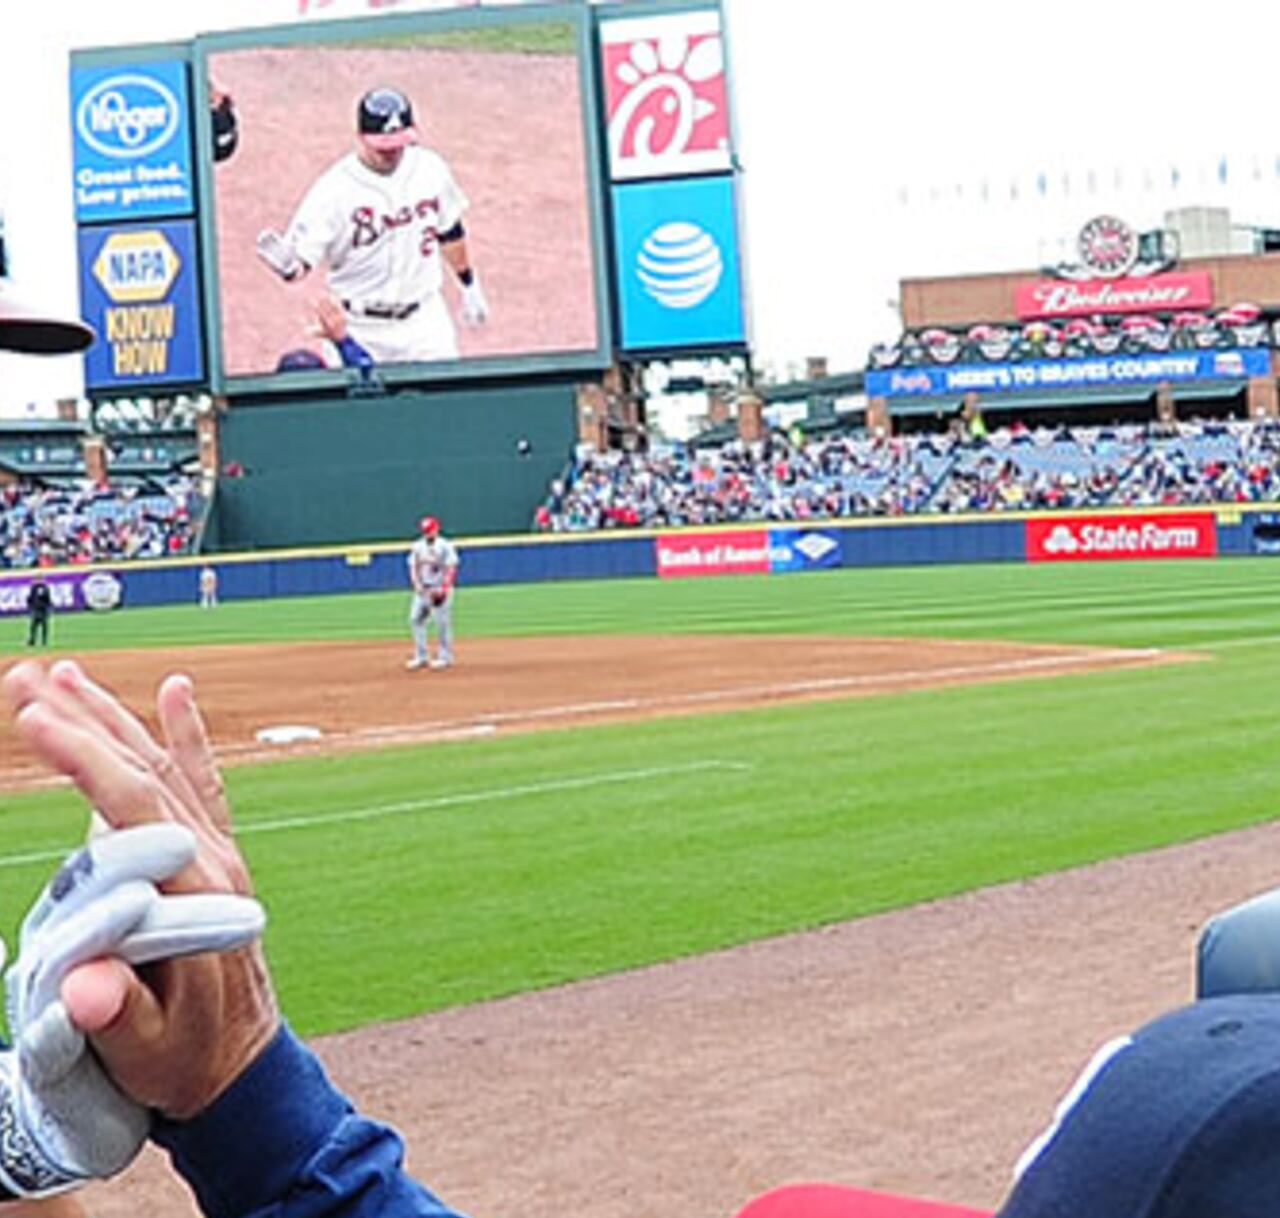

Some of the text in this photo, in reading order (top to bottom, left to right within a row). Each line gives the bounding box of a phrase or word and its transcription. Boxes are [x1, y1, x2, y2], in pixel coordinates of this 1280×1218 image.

[91, 91, 167, 146] Kroger
[77, 187, 117, 205] Low
[109, 251, 168, 283] NAPA
[1033, 282, 1192, 314] Budweiser
[105, 303, 175, 342] KNOW
[114, 339, 168, 375] HOW
[1012, 366, 1036, 384] TO
[660, 548, 701, 566] Bank
[703, 547, 720, 564] of
